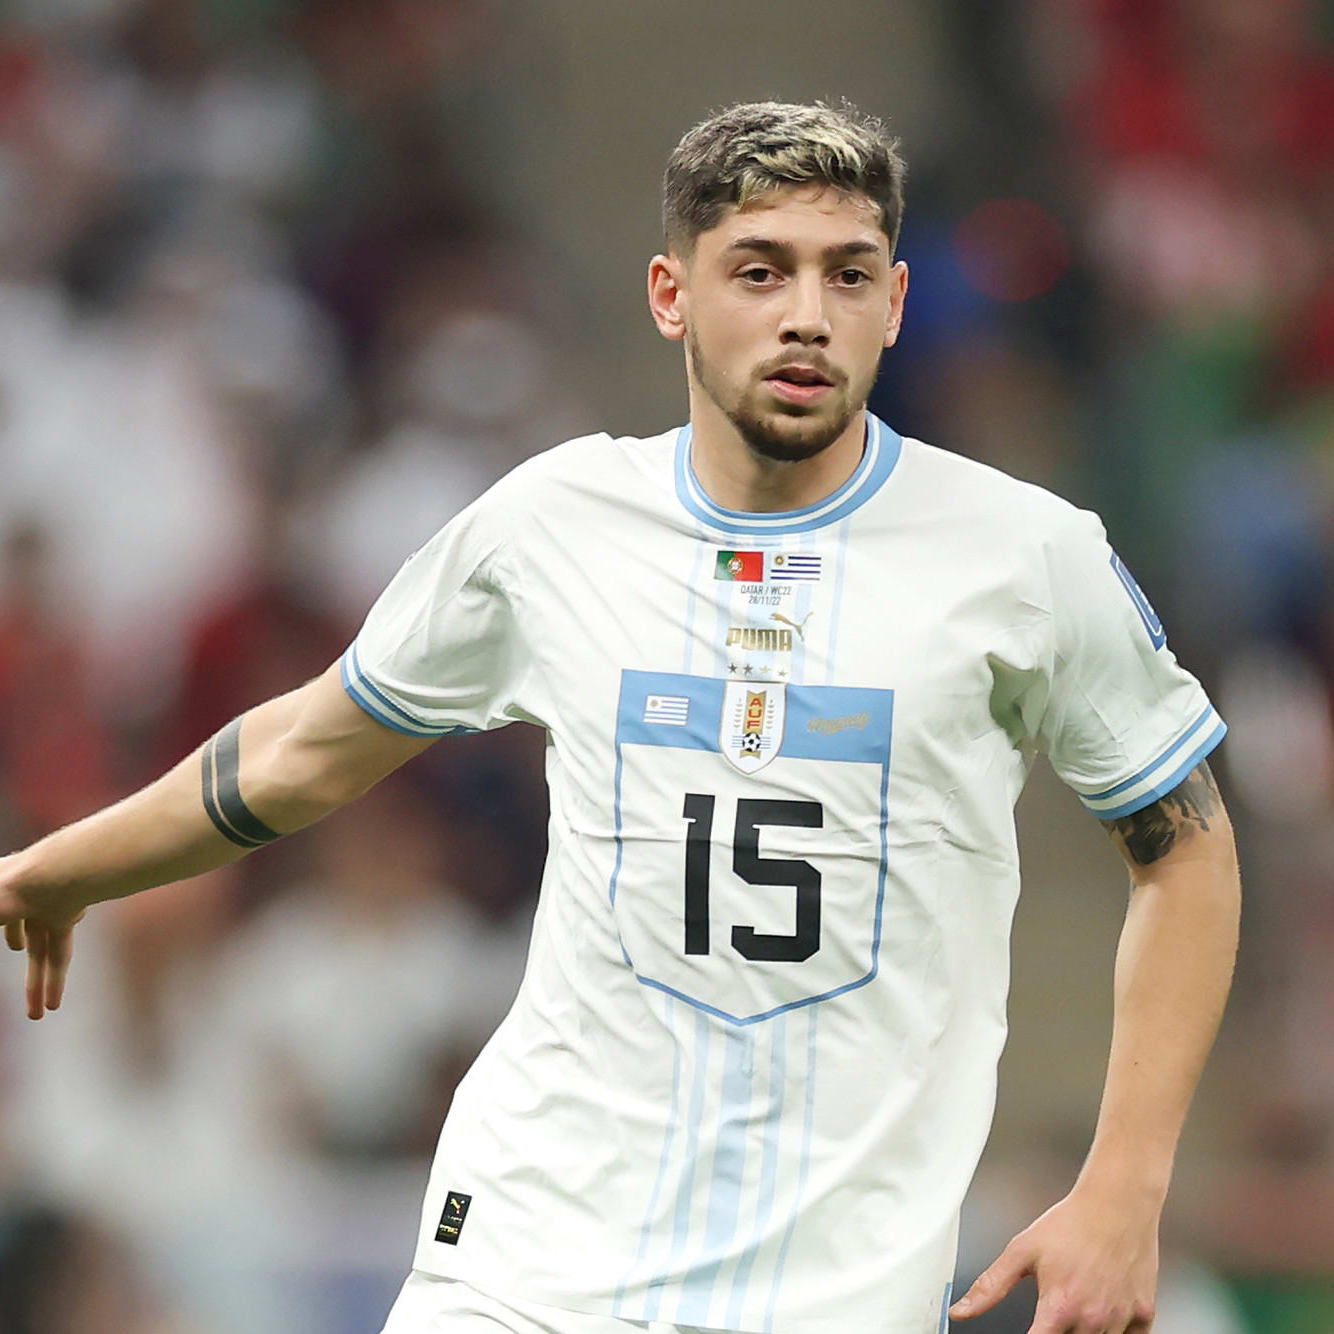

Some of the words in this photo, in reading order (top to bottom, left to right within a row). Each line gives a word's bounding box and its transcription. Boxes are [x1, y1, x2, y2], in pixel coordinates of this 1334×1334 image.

[725, 627, 793, 652] PUMA
[747, 697, 763, 729] AUF
[682, 792, 823, 963] 15
